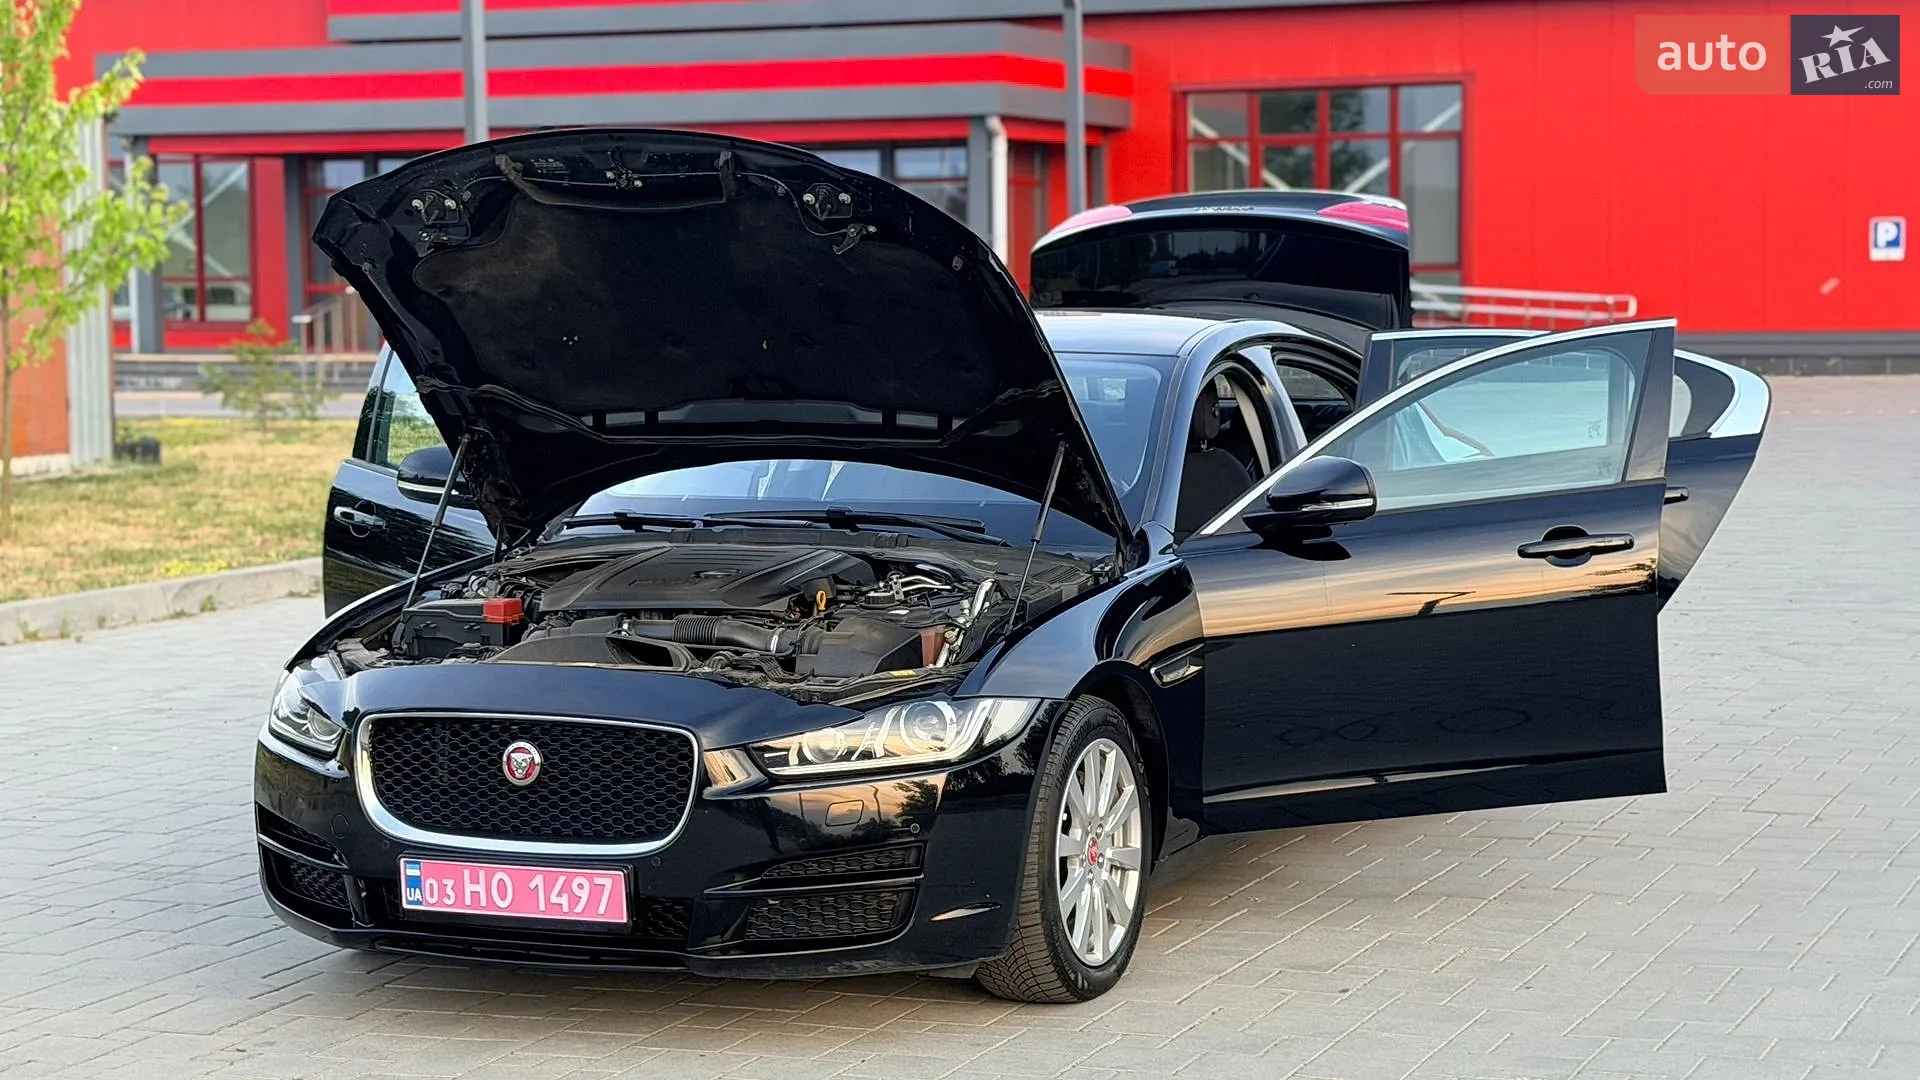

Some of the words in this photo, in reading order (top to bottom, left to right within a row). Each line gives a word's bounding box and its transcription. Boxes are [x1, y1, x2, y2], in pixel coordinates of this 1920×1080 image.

[1877, 221, 1898, 249] P
[407, 887, 423, 902] UA
[425, 877, 456, 905] 03
[463, 869, 514, 909] HO
[528, 874, 614, 916] 1497
